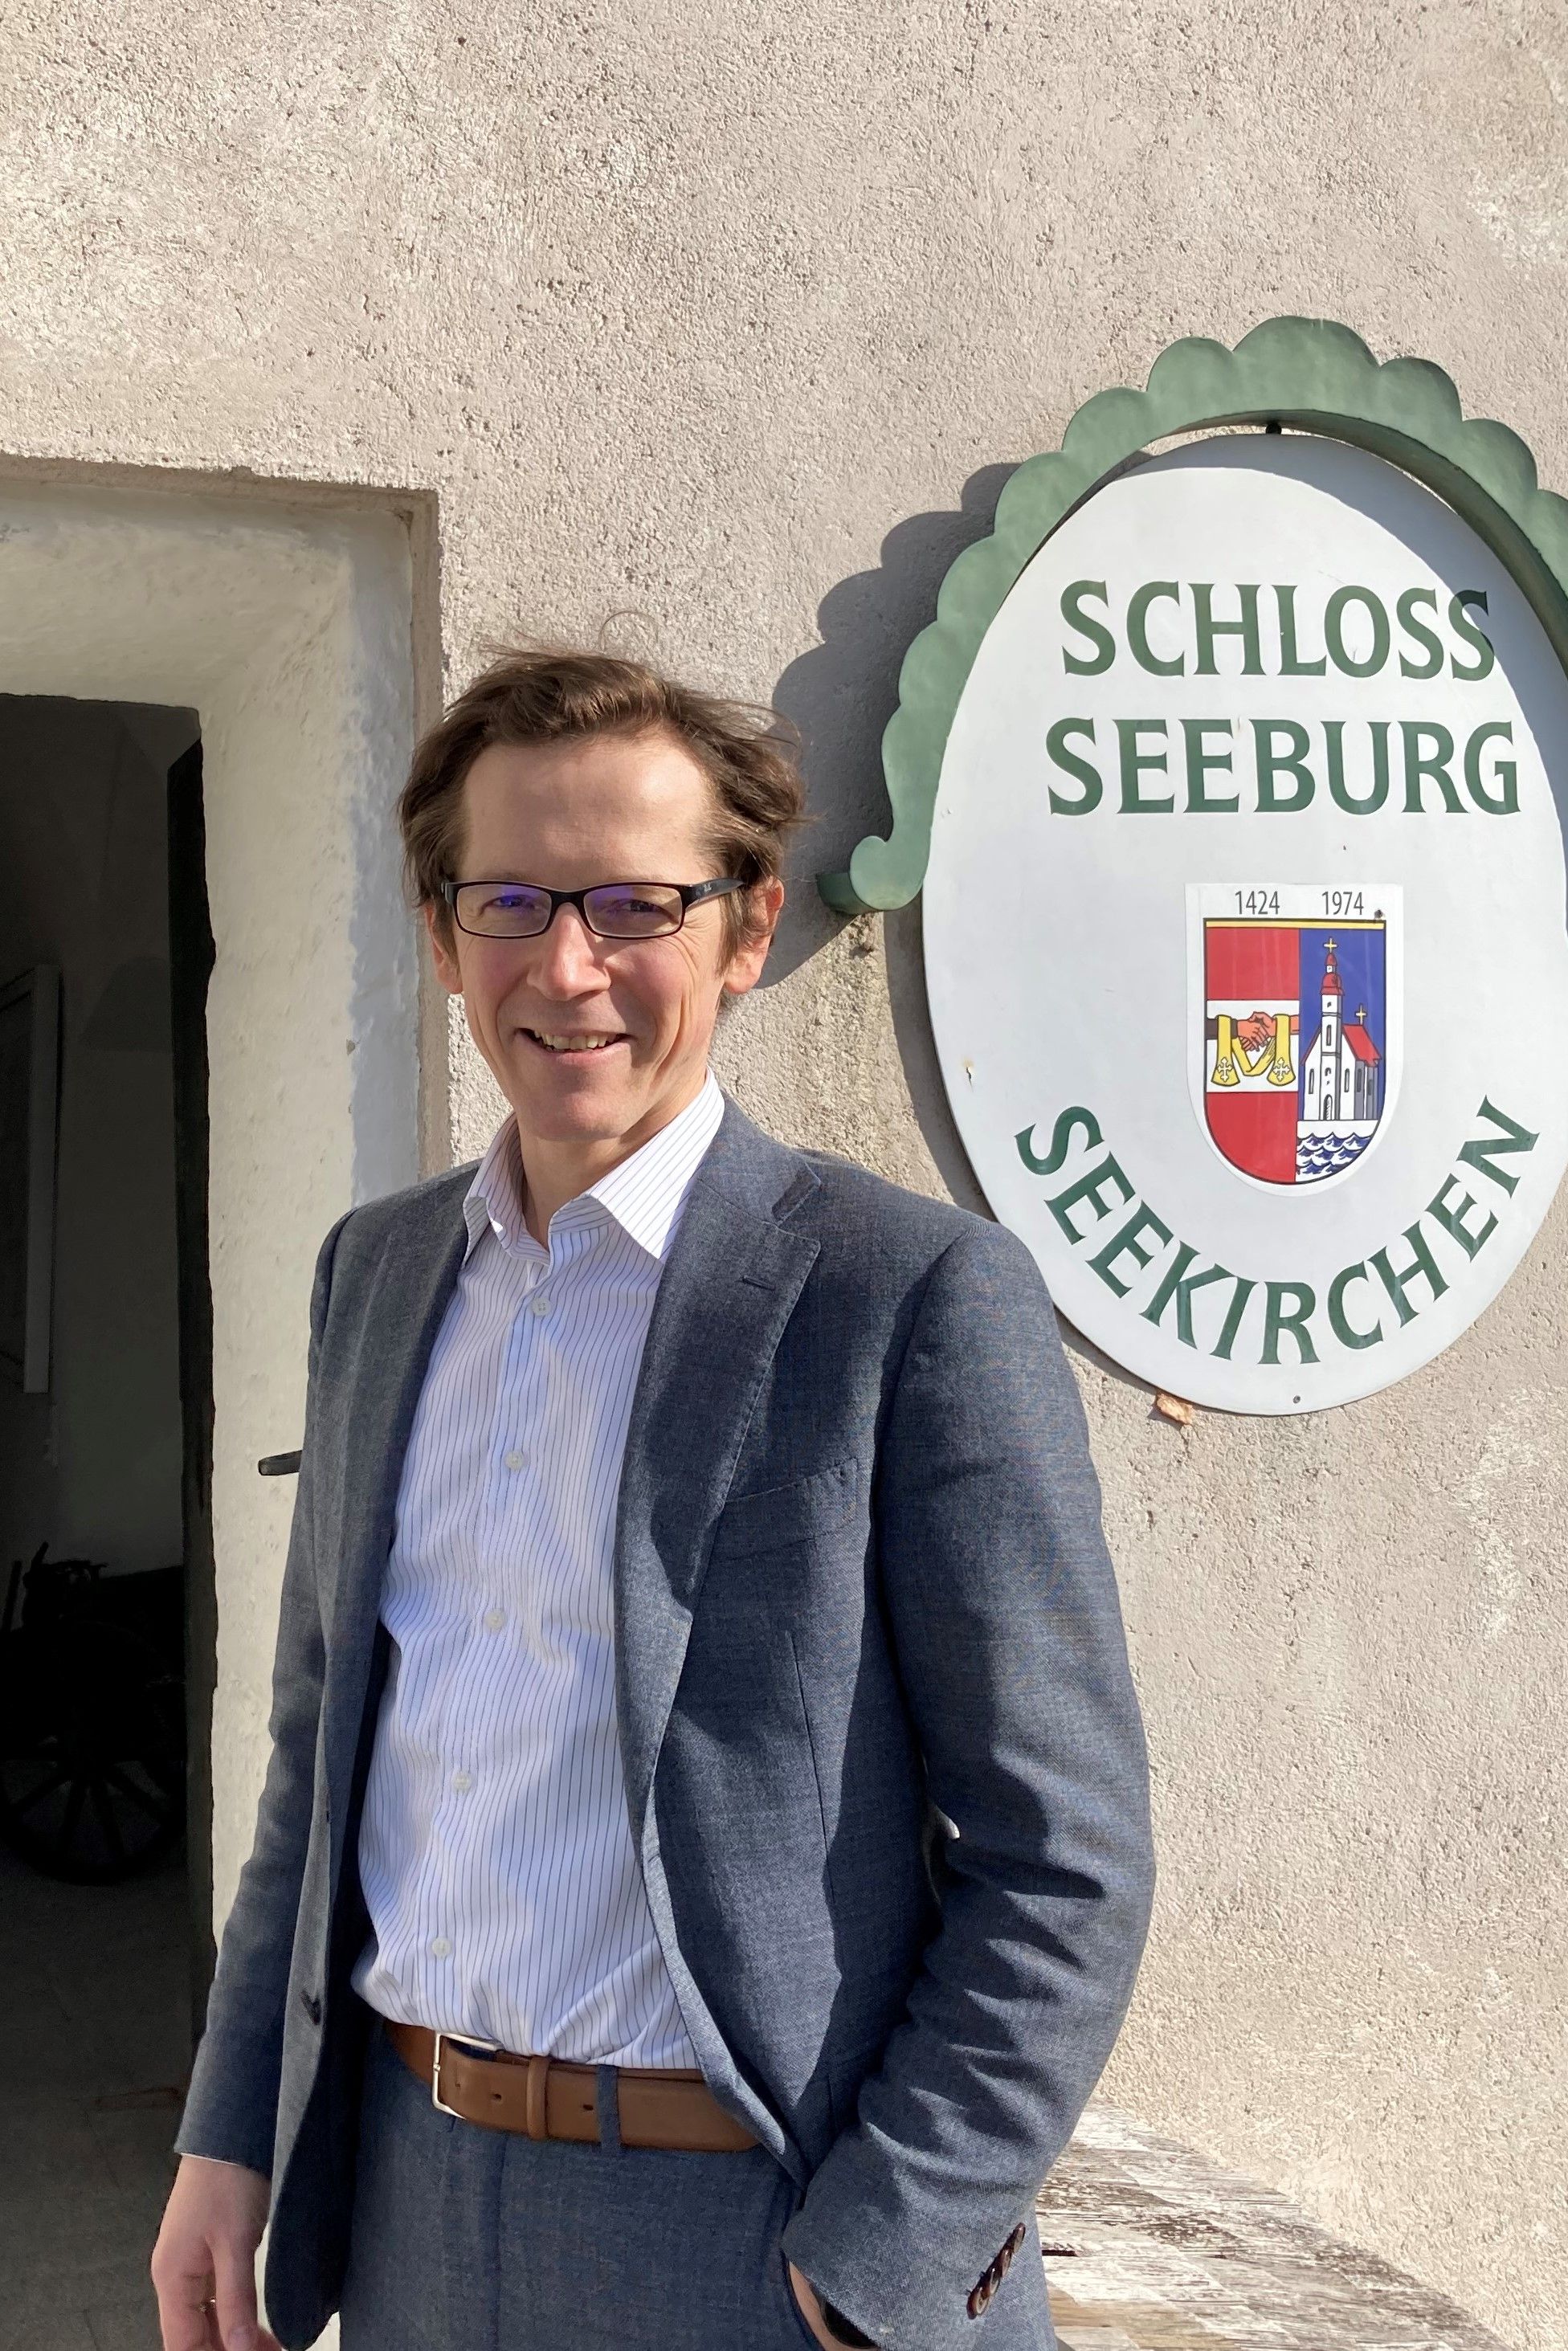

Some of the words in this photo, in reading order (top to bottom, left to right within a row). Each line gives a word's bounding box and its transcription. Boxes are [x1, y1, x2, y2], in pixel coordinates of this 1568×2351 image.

[1060, 579, 1496, 681] SCHLOSS
[1045, 717, 1521, 815] SEEBURG
[1235, 891, 1280, 915] 1424
[1321, 892, 1364, 916] 1974
[1014, 1094, 1541, 1365] SEEKIRCHEN
